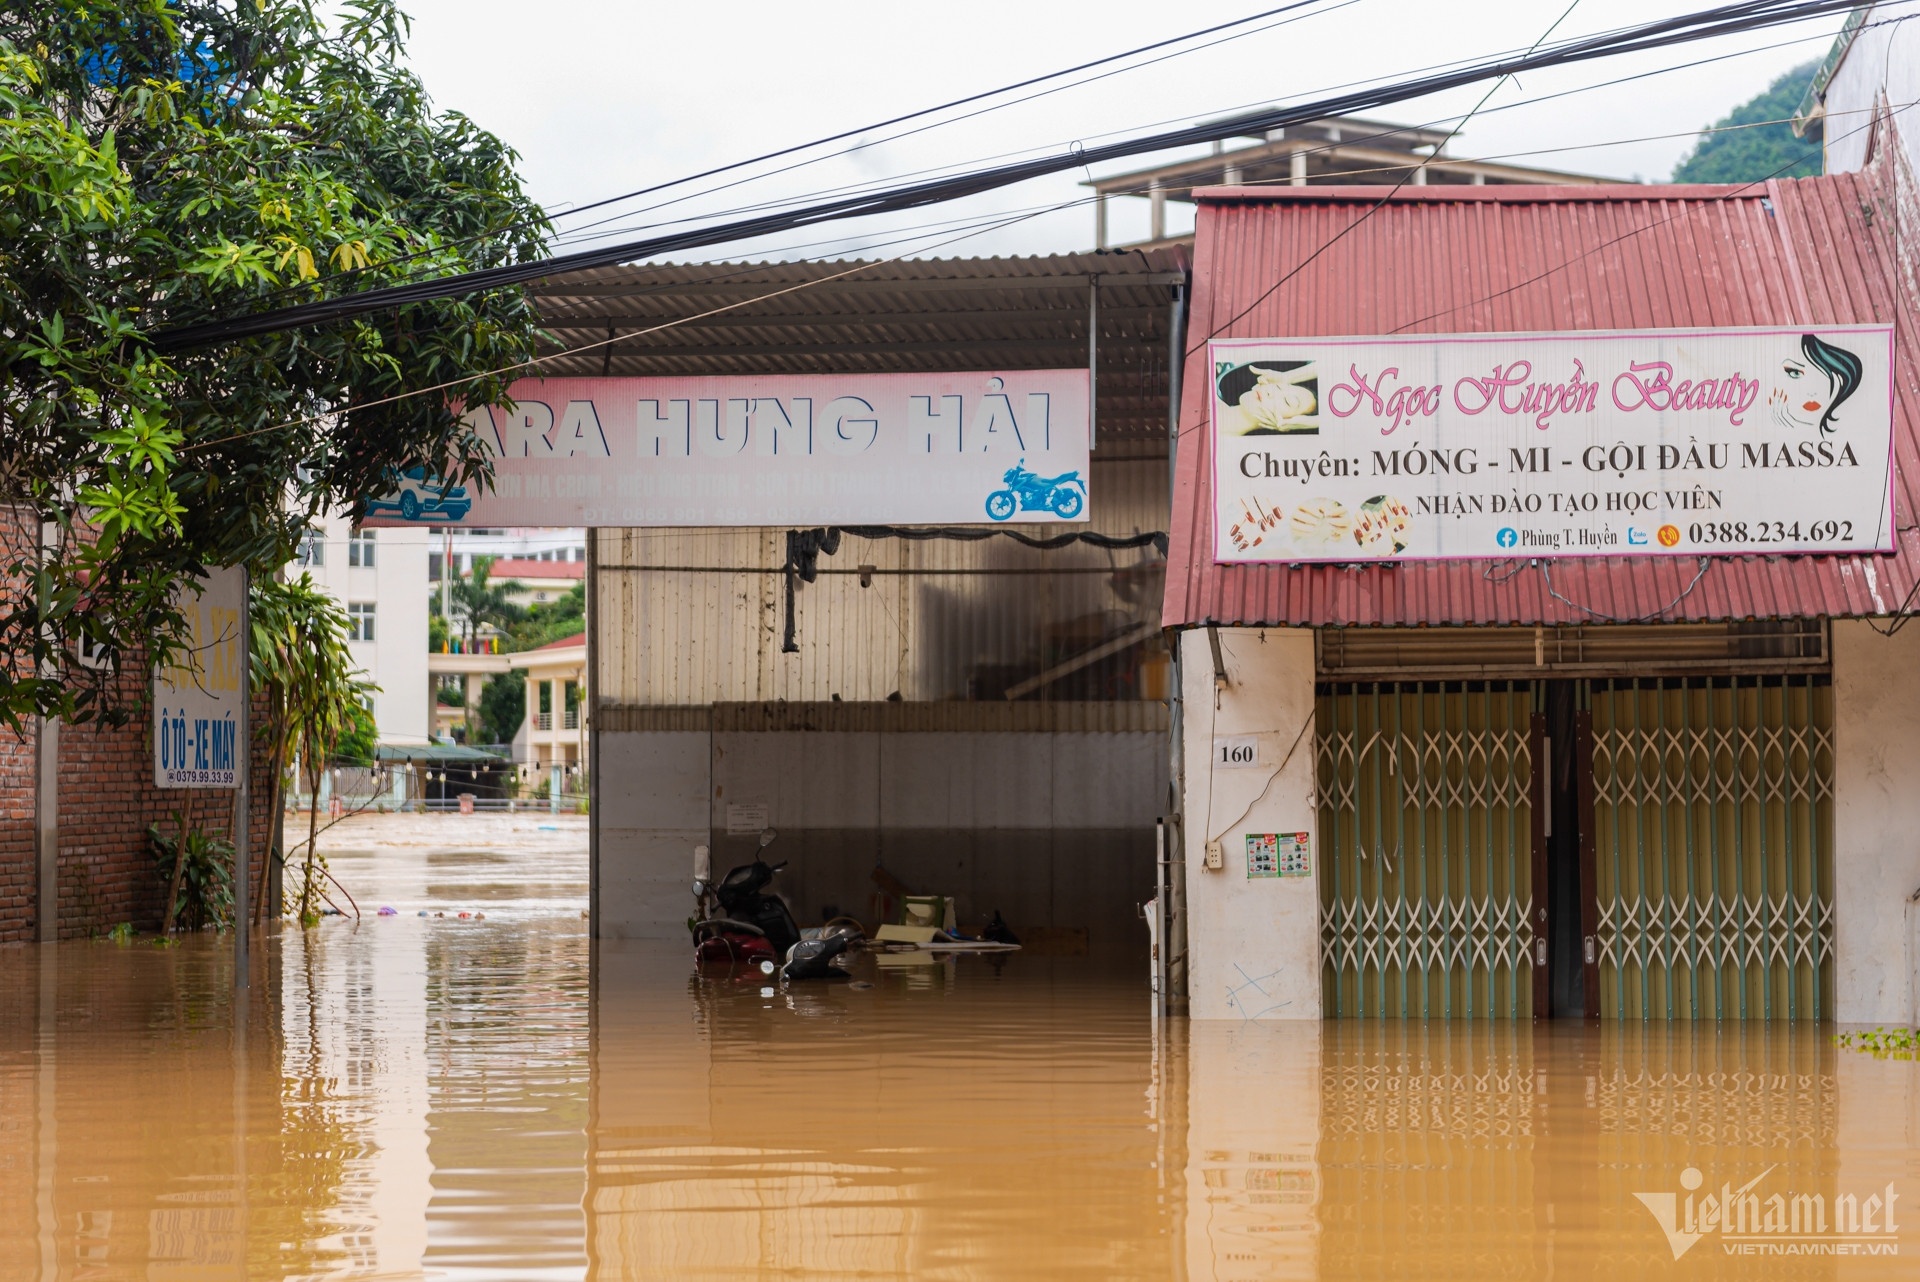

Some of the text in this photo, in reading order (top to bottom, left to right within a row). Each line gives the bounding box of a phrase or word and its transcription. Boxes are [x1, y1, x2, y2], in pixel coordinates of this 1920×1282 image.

[636, 396, 878, 457] HƯNG
[907, 376, 1050, 454] HẢI
[1328, 357, 1760, 436] Ngọc Huyền Beauty
[1239, 449, 1360, 485] Chuyên:
[1370, 441, 1479, 476] MÓNG
[1507, 447, 1552, 473] MI
[1582, 440, 1647, 479] GỘI
[1656, 435, 1729, 471] ĐẦU
[1740, 440, 1860, 469] MASSA
[1415, 484, 1723, 519] NHẬN ĐÀO TẠO HỌC VIÊN
[1522, 527, 1560, 550] Phùng
[1563, 528, 1575, 546] T.
[1579, 522, 1618, 550] Huyền
[1688, 520, 1854, 545] 0388.234.692
[162, 707, 169, 770] Ô
[172, 708, 186, 770] TÔ
[195, 718, 208, 770] XE
[212, 710, 235, 770] MÁY
[1221, 745, 1254, 763] 160
[176, 770, 234, 784] 0379.99.33.99
